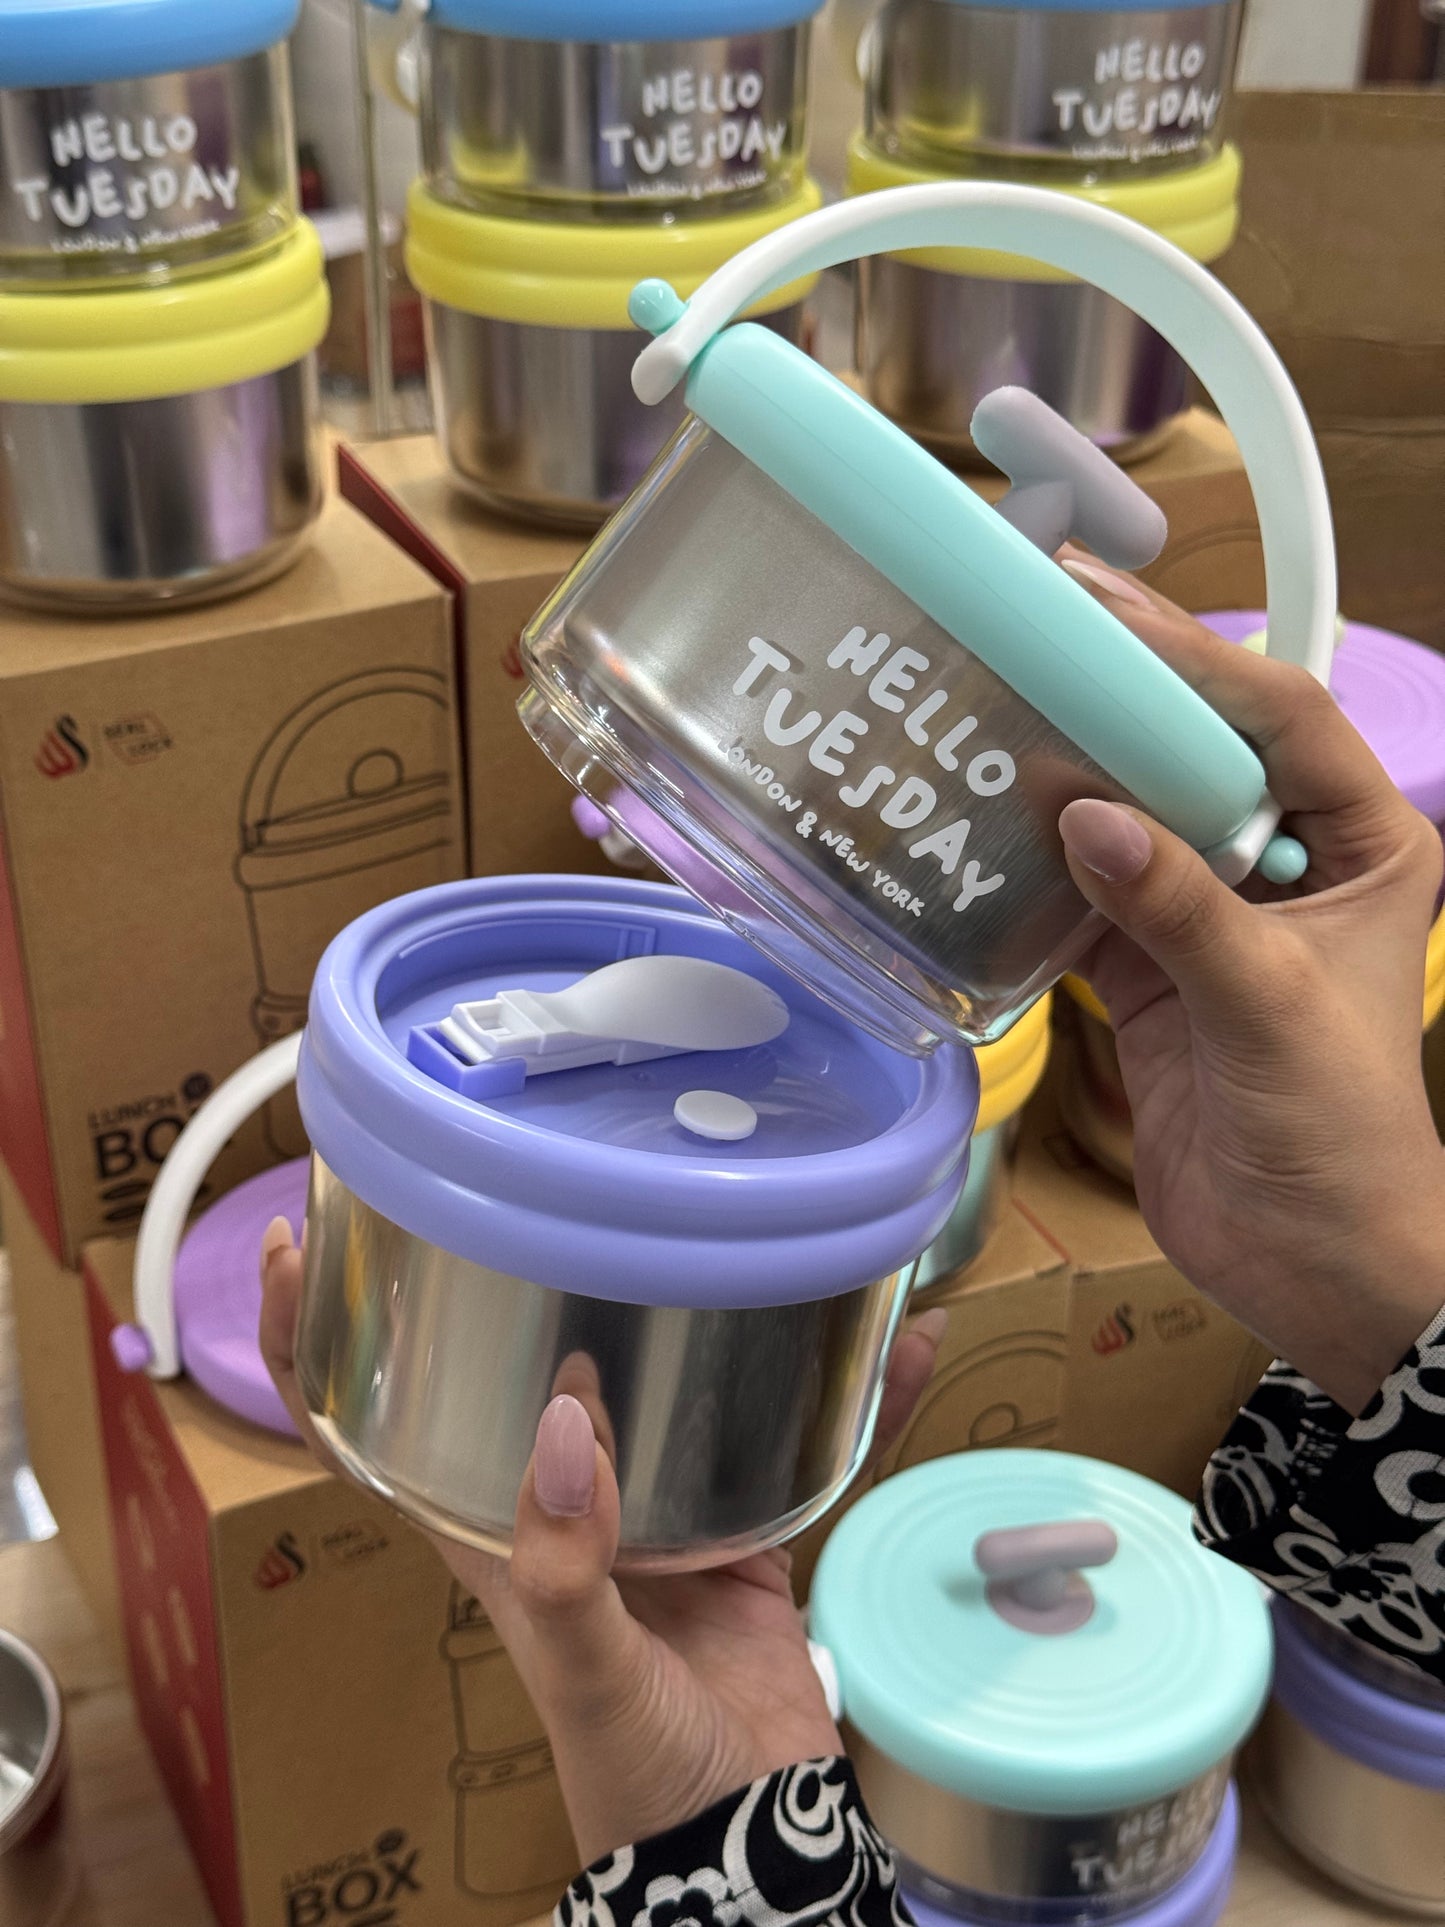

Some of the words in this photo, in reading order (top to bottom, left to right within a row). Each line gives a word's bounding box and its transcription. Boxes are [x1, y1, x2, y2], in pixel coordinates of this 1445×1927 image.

[1095, 38, 1206, 83] HELLO
[642, 69, 764, 117] HELLO
[1051, 85, 1222, 137] TUESDAY
[51, 114, 198, 167] HELLO
[600, 117, 787, 175] TUESDAY
[13, 162, 240, 227] TUESDAY
[827, 626, 1016, 796] HELLO
[732, 636, 1005, 912] TUESDAY
[717, 739, 802, 812] LONDON
[795, 811, 818, 838] &
[819, 829, 870, 872] NEW
[873, 869, 925, 917] YORK
